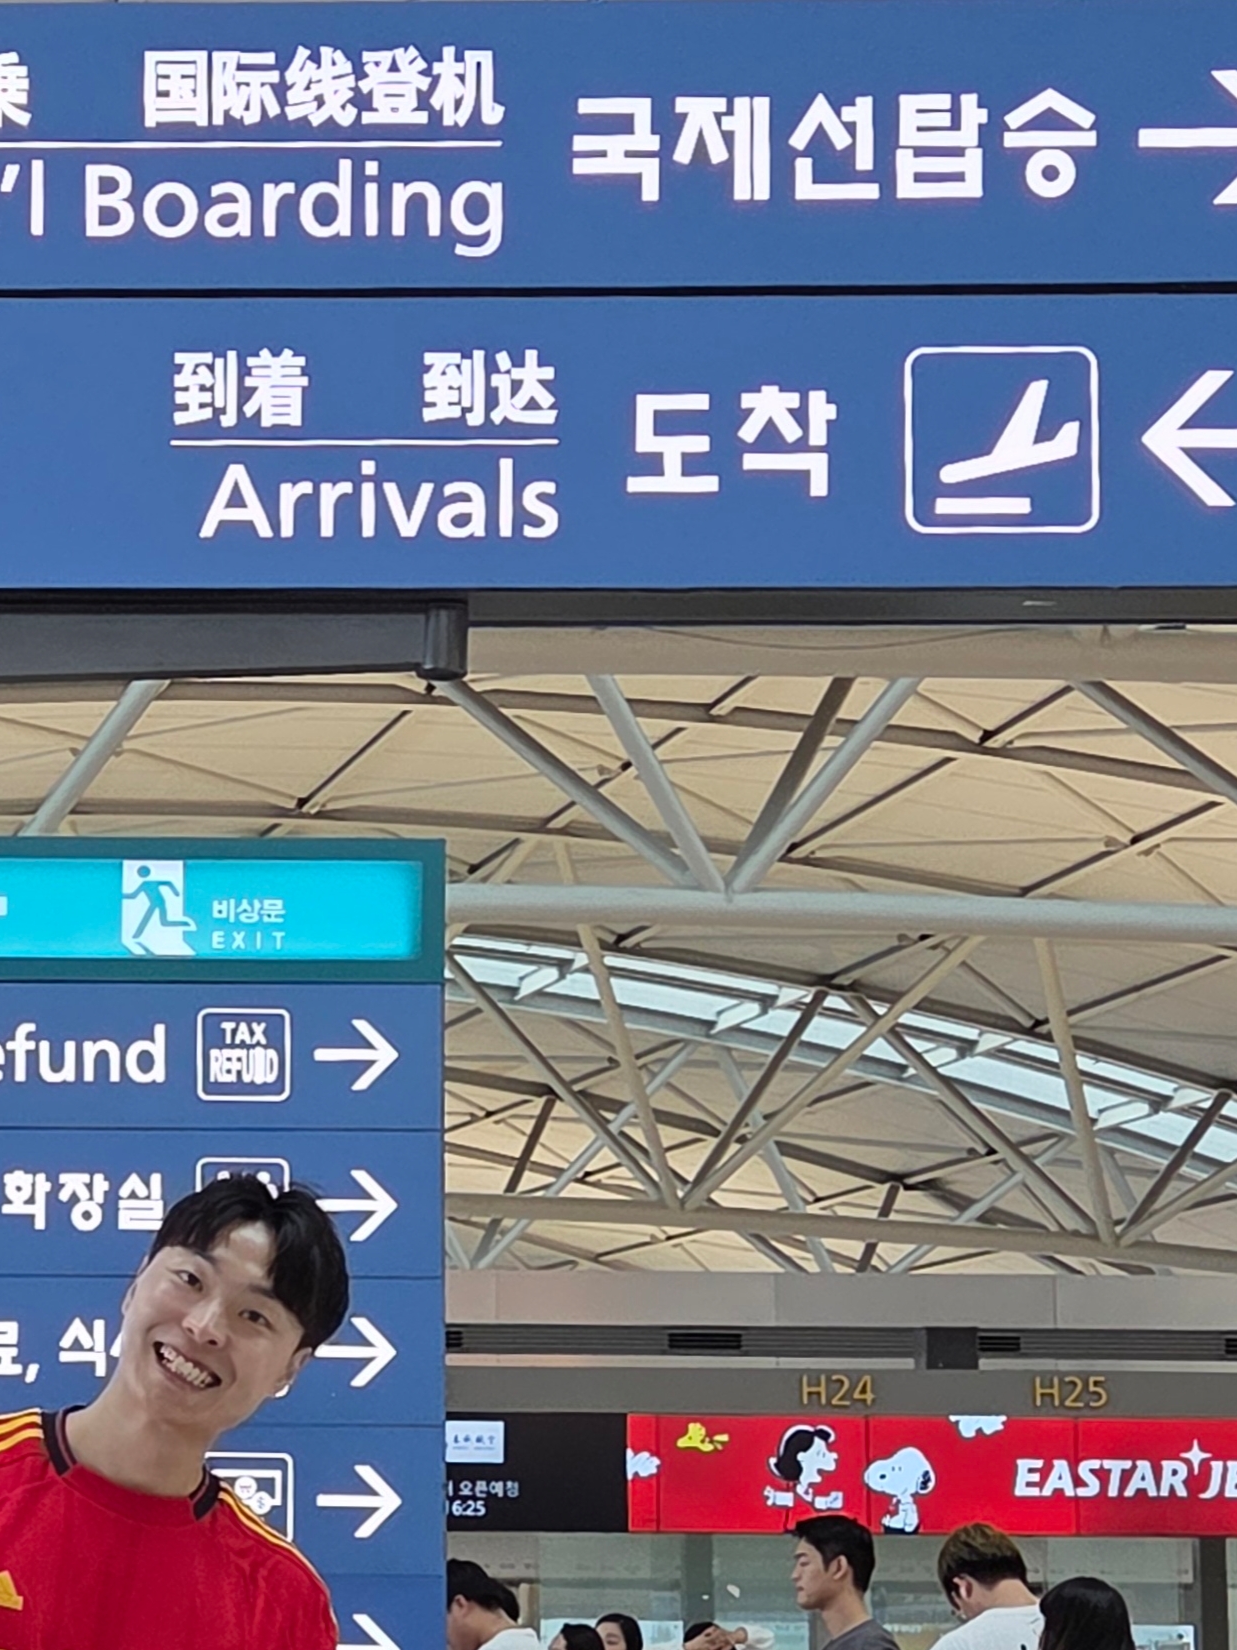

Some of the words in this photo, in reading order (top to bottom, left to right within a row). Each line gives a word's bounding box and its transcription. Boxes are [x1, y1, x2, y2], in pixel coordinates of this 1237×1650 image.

[143, 45, 506, 128] 国际线登机
[572, 87, 1097, 202] 국제선탑승
[85, 158, 503, 257] Boarding
[173, 347, 309, 428] 到着
[422, 349, 559, 427] 到达
[626, 385, 837, 497] 도착
[199, 457, 559, 539] Arrivals
[211, 898, 287, 924] 비상문
[211, 930, 287, 951] EXIT
[220, 1021, 267, 1045] TAX
[209, 1046, 279, 1085] REFUND
[1, 1169, 164, 1232] 화장실
[58, 1317, 121, 1383] 식
[800, 1373, 876, 1407] H24
[1032, 1375, 1109, 1409] H25
[1014, 1457, 1189, 1499] EASTAR
